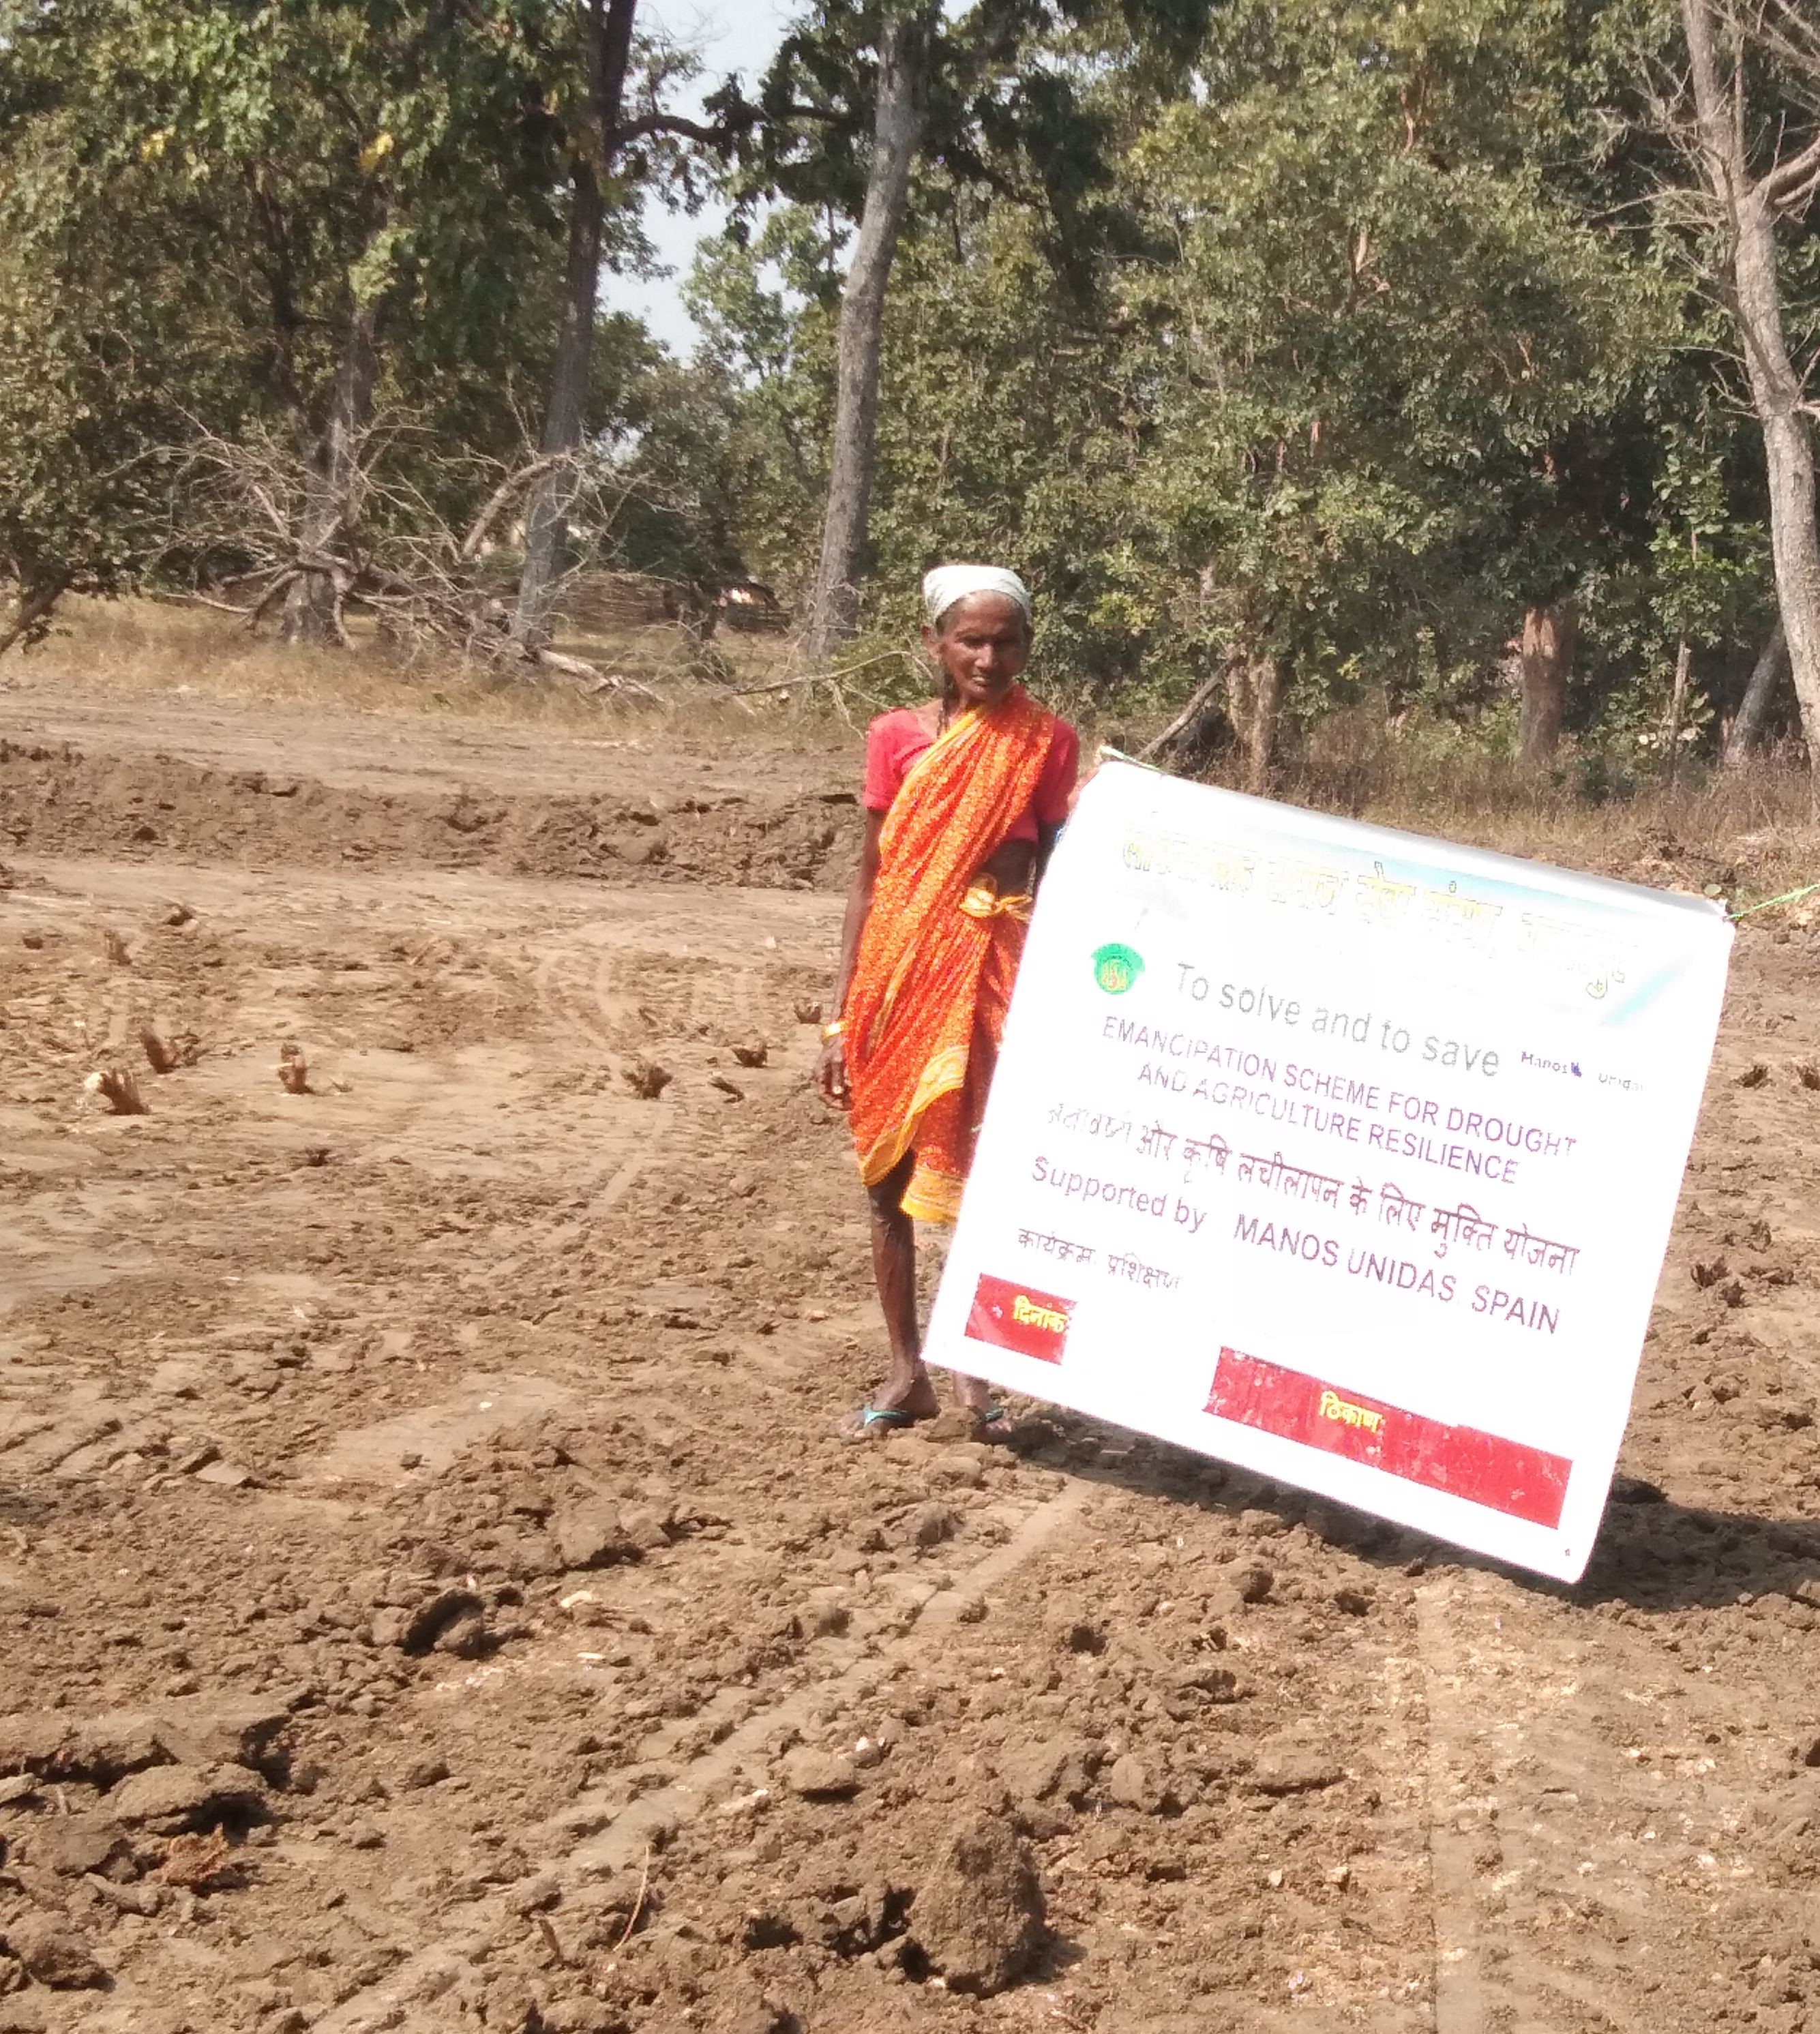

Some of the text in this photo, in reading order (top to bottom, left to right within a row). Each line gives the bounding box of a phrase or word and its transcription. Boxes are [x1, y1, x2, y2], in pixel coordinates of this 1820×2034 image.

[1178, 961, 1209, 1001] To
[1219, 984, 1300, 1026] solve
[1312, 1006, 1371, 1043] and
[1381, 1019, 1410, 1053] to
[1422, 1036, 1500, 1077] save
[1103, 1016, 1577, 1156] EMANCIPATION SCHEME FOR DROUGHT
[1137, 1062, 1187, 1092] AND
[1193, 1079, 1362, 1142] AGRICULTURE
[1368, 1123, 1521, 1184] RESILIENCE
[1032, 1155, 1169, 1217] Supported
[1174, 1196, 1208, 1233] by
[1233, 1213, 1340, 1268] MANOS
[1471, 1285, 1560, 1335] SPAIN
[1238, 1150, 1345, 1208] लचीलापन
[1349, 1176, 1373, 1216] के
[1378, 1182, 1426, 1231] लिए
[1503, 1223, 1581, 1276] योजना
